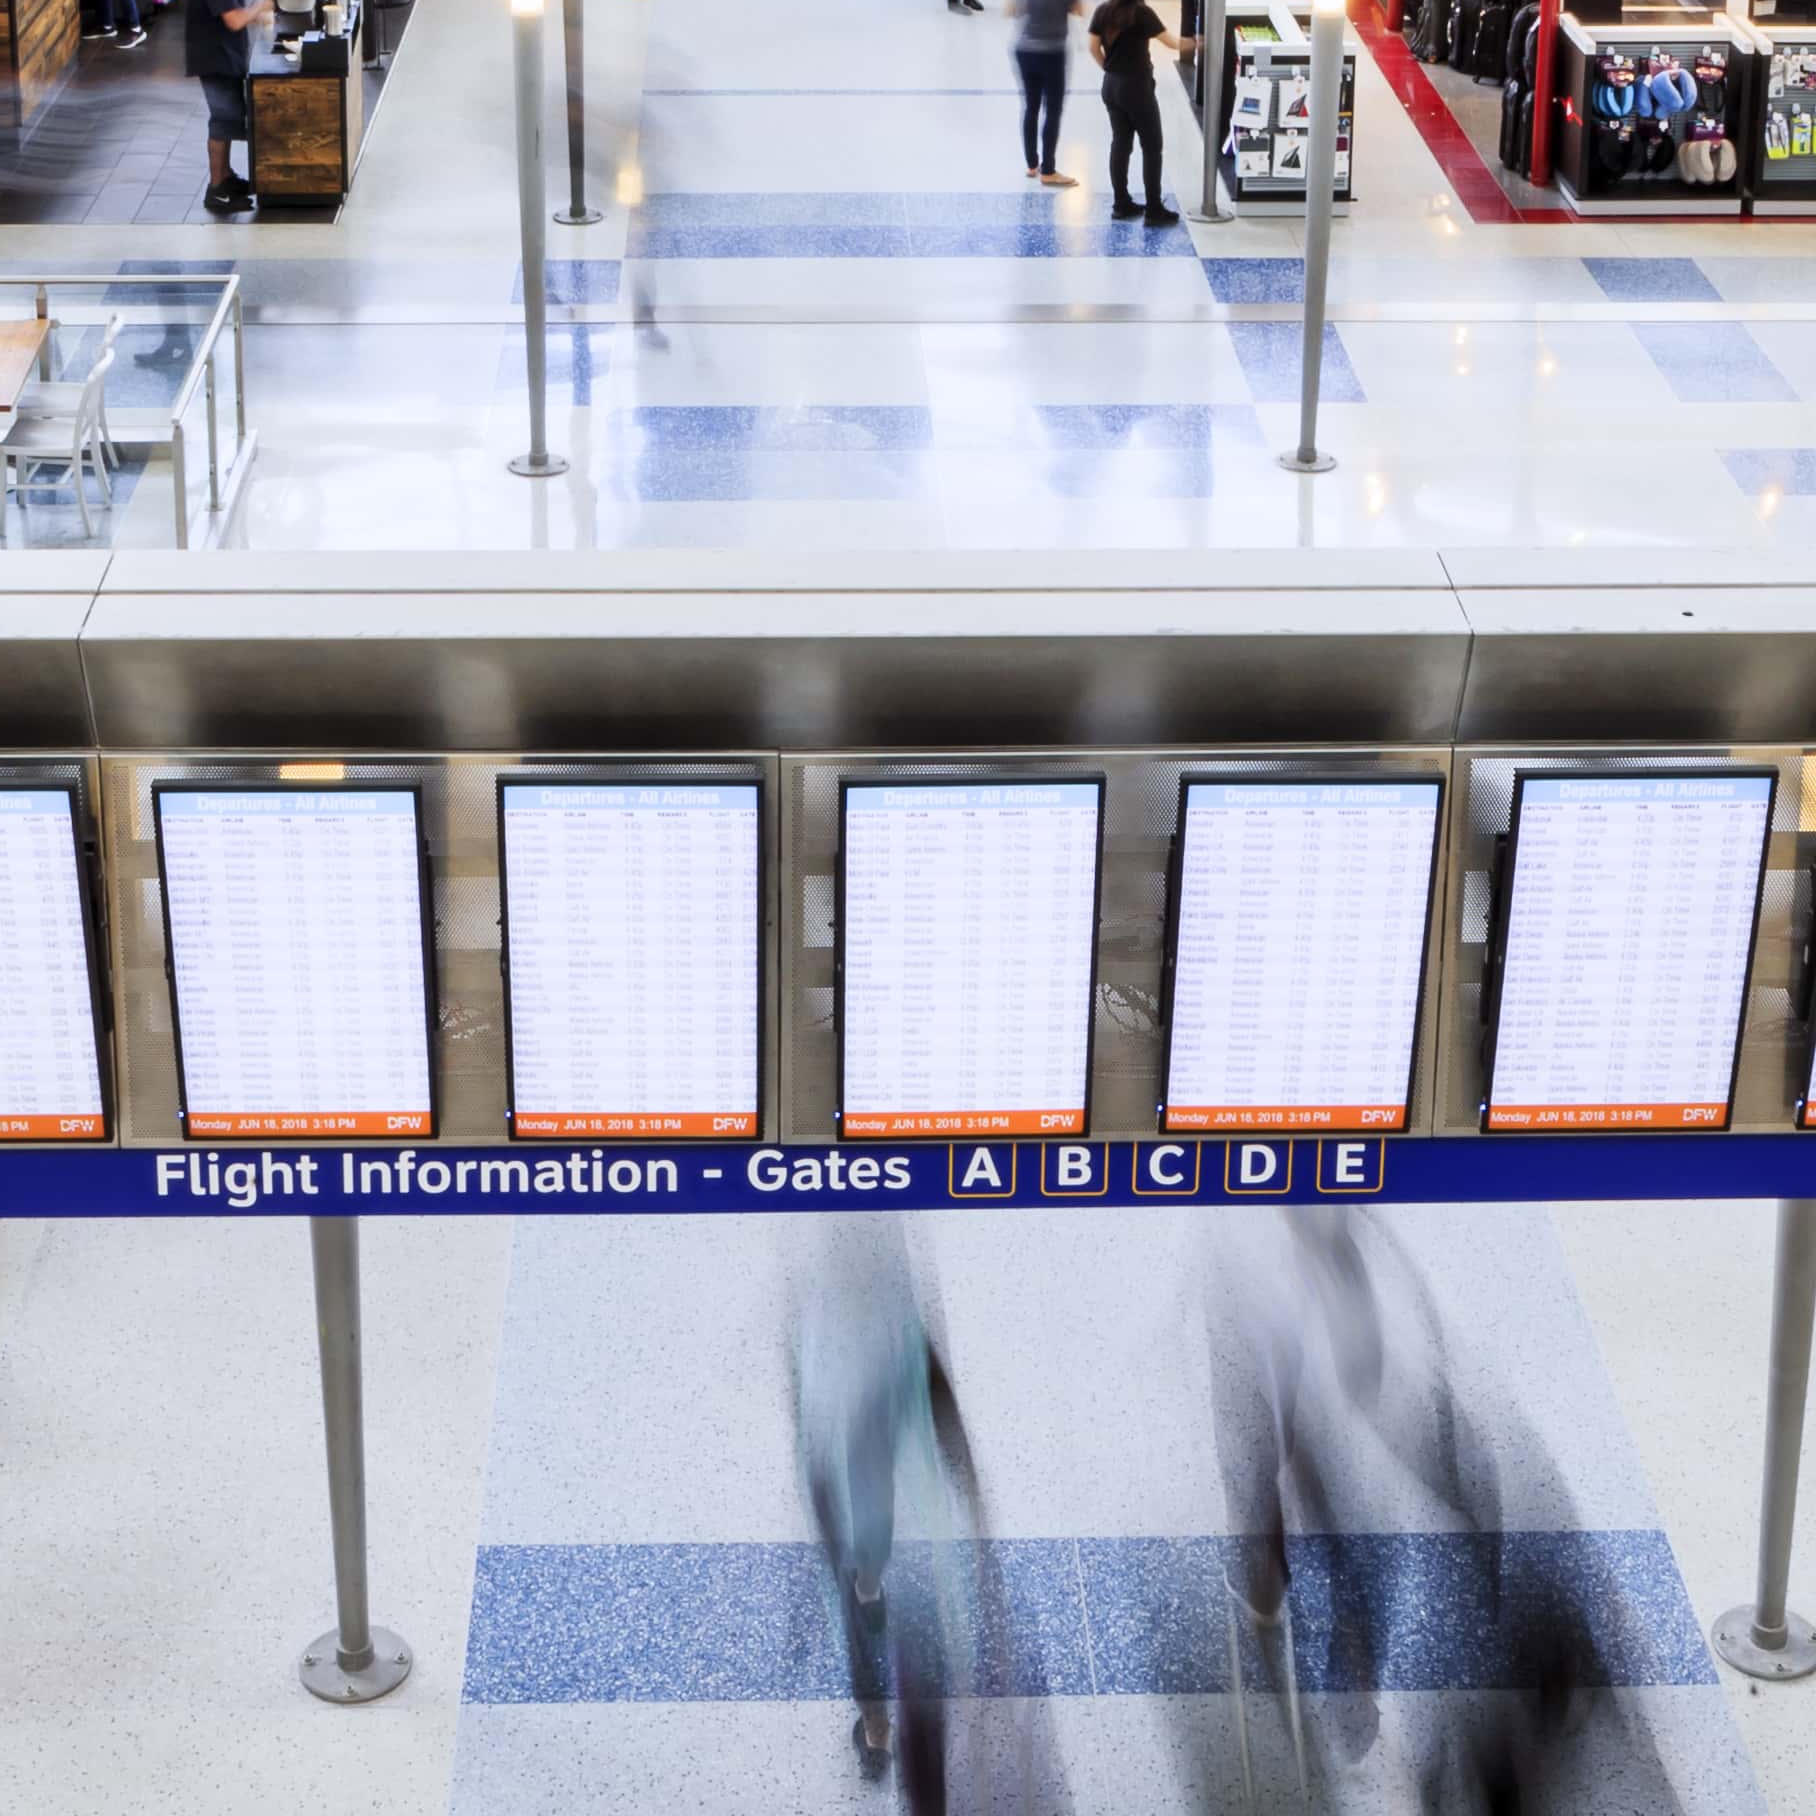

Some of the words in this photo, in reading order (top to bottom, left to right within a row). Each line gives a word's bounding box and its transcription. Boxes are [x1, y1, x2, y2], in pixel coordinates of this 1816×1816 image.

[884, 790, 967, 806] Departures
[983, 790, 1000, 804] All
[1007, 789, 1061, 803] Airlines
[1224, 789, 1306, 806] Departures
[1320, 788, 1338, 802] All
[1344, 788, 1400, 802] Airlines
[1559, 784, 1640, 800] Departures
[1654, 783, 1674, 797] All
[1678, 783, 1736, 797] Airlines
[198, 796, 280, 813] Departures
[295, 796, 314, 810] All
[319, 796, 376, 810] Airlines
[541, 791, 624, 807] Departures
[639, 791, 657, 804] All
[663, 791, 720, 804] Airlines
[1040, 1114, 1075, 1129] DFW
[1168, 1112, 1209, 1125] Monday
[1214, 1112, 1237, 1123] JUN
[1257, 1112, 1283, 1123] 2018
[1288, 1111, 1310, 1123] 3:18
[1312, 1111, 1331, 1123] PM
[1360, 1109, 1397, 1124] DFW
[1490, 1112, 1531, 1124] Monday
[1536, 1111, 1560, 1123] JUN
[1579, 1111, 1606, 1122] 2018
[1610, 1110, 1632, 1121] 3:18
[1634, 1110, 1653, 1121] PM
[1682, 1108, 1718, 1122] DFW
[11, 1121, 29, 1132] PM
[59, 1119, 95, 1133] DFW
[190, 1119, 232, 1131] Monday
[238, 1119, 261, 1130] JUN
[281, 1118, 308, 1129] 2018
[313, 1118, 335, 1129] 3:18
[337, 1118, 356, 1129] PM
[386, 1116, 423, 1130] DFW
[517, 1119, 559, 1132] Monday
[564, 1119, 587, 1130] JUN
[607, 1119, 634, 1130] 2018
[639, 1119, 661, 1130] 3:18
[663, 1119, 682, 1130] PM
[712, 1117, 748, 1131] DFW
[845, 1119, 887, 1132] Monday
[892, 1119, 915, 1130] JUN
[935, 1118, 962, 1129] 2018
[967, 1116, 989, 1129] 3:18
[991, 1116, 1010, 1128] PM
[154, 1151, 319, 1208] Flight
[341, 1149, 679, 1195] Information
[701, 1171, 724, 1181] -
[746, 1147, 912, 1193] Gates
[961, 1146, 1002, 1188] A
[1057, 1146, 1093, 1186] B
[1148, 1144, 1185, 1185] C
[1239, 1143, 1277, 1184] D
[1335, 1143, 1366, 1184] E
